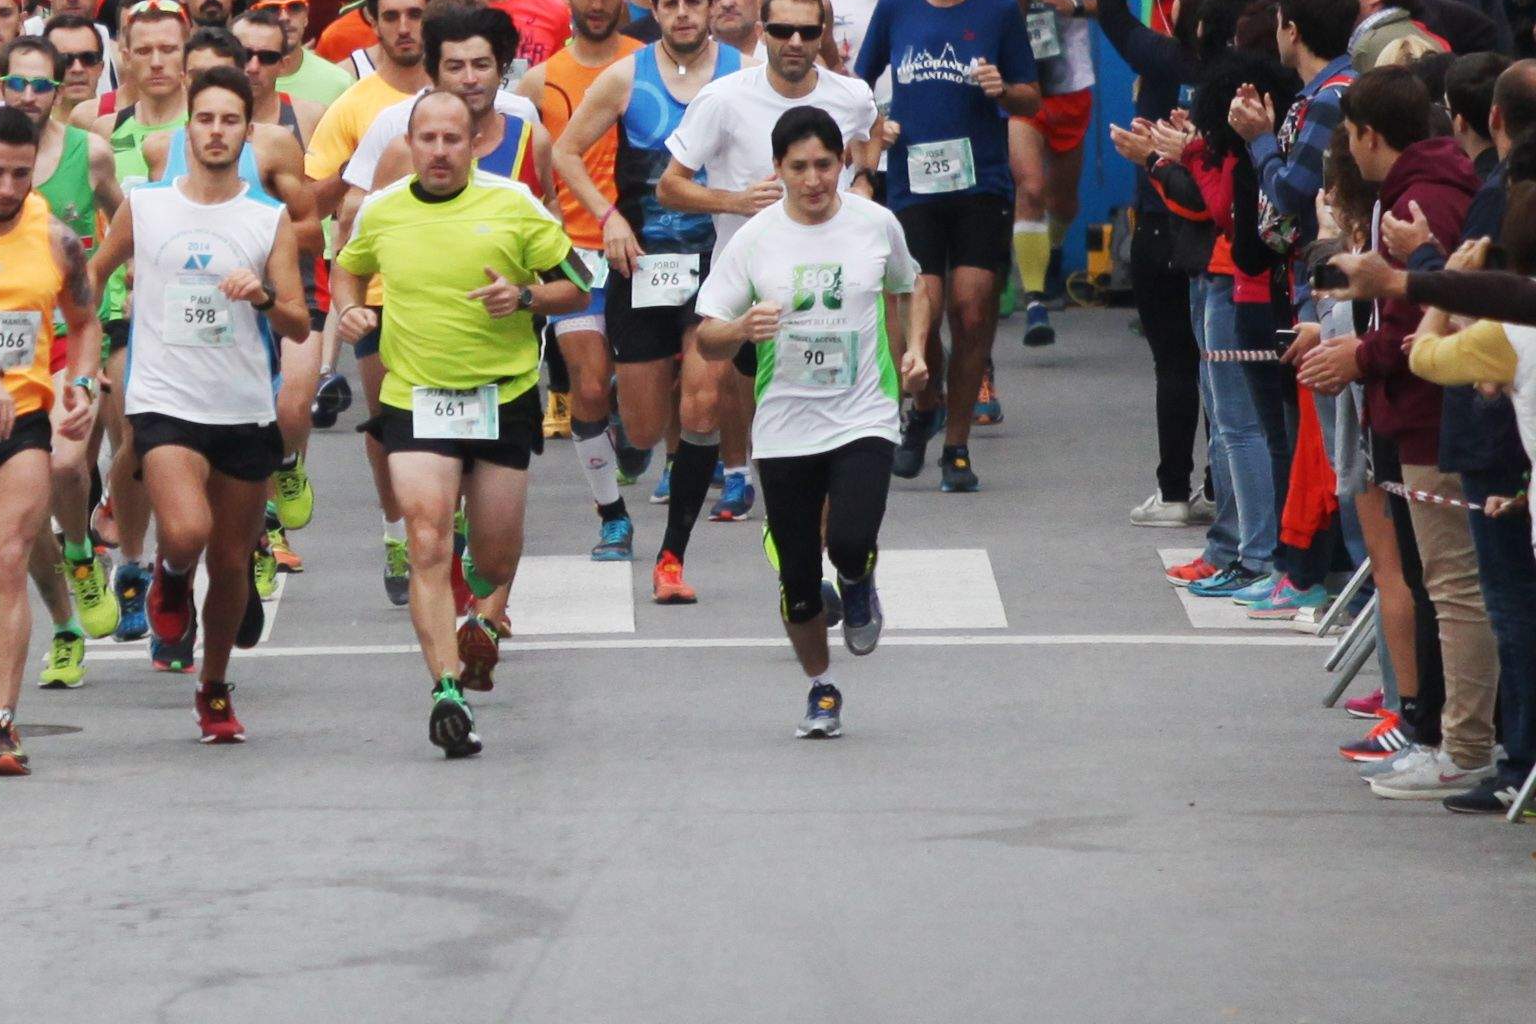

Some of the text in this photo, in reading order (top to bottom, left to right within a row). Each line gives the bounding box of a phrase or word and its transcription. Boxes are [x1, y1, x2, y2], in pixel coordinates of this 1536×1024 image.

[923, 159, 951, 175] 235
[654, 261, 679, 270] JORDI
[650, 272, 680, 287] 696
[190, 295, 212, 305] PAU
[184, 308, 216, 324] 598
[803, 350, 825, 365] 90
[434, 401, 464, 416] 661
